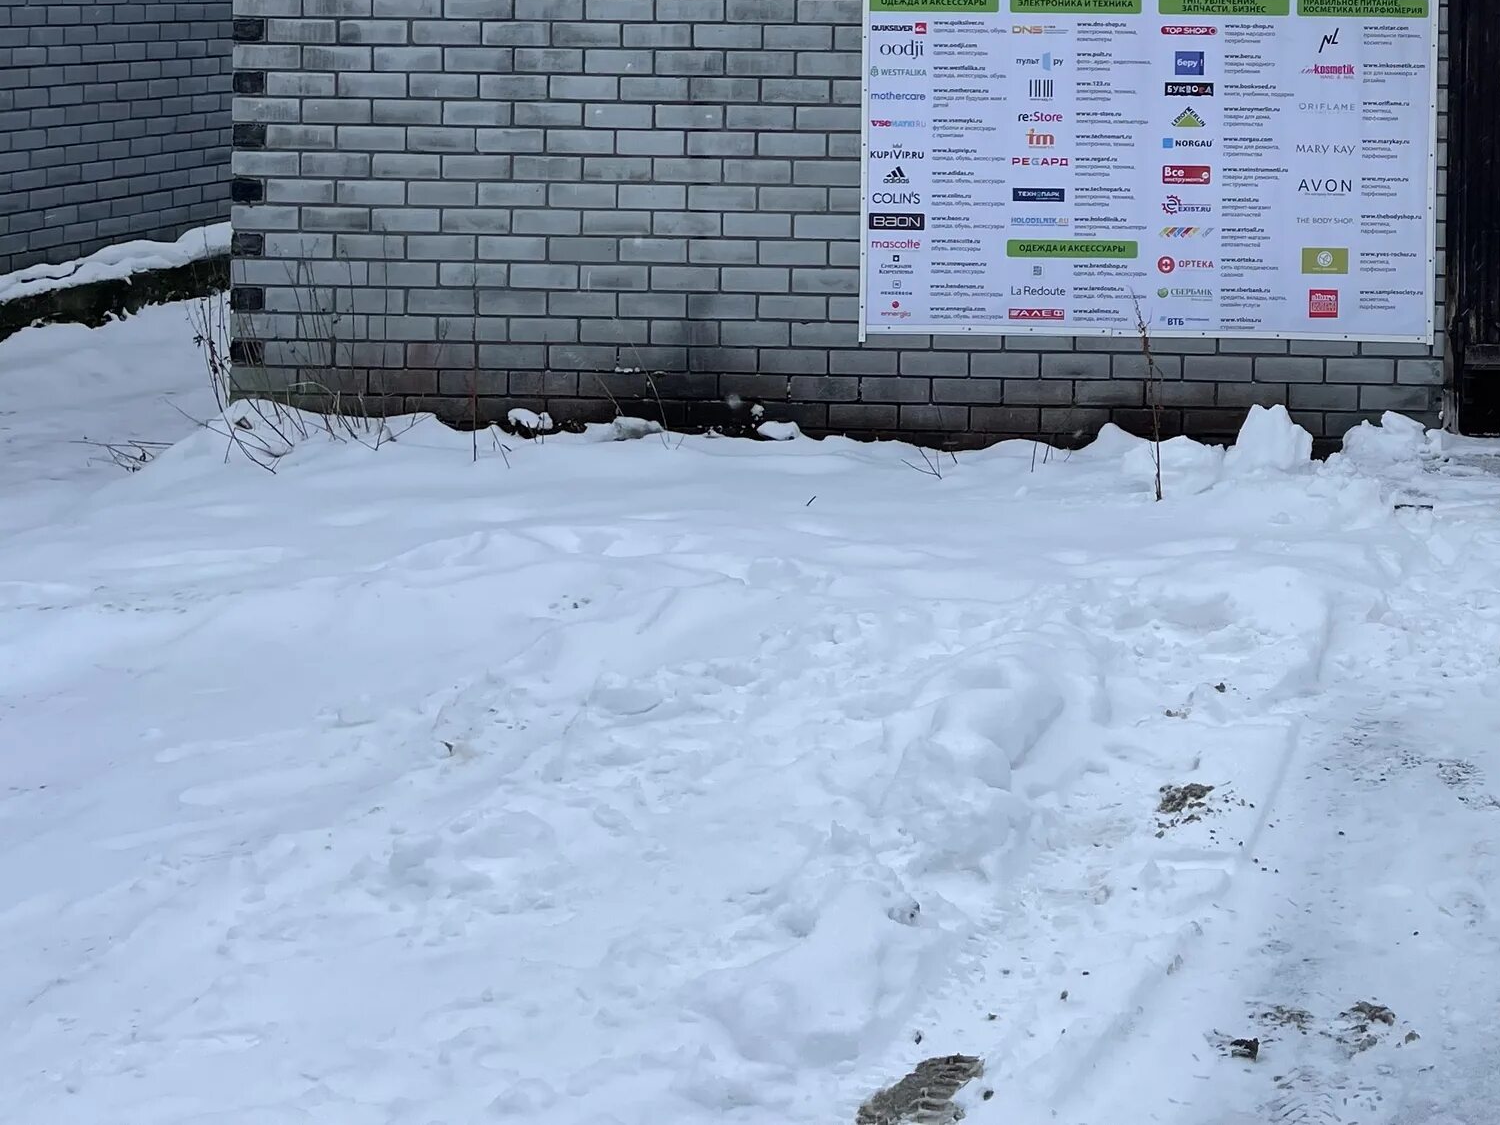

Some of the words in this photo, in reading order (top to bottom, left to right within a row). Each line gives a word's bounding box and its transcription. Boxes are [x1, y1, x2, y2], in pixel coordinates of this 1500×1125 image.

[1018, 0, 1082, 7] ЭЛЕКТРОНИКА
[1359, 0, 1400, 7] ПИТАНИЕ,
[1182, 5, 1230, 13] ЗАПЧАСТИ,
[1232, 5, 1266, 13] БИЗНЕС
[1355, 6, 1361, 14] И
[1363, 6, 1423, 14] ПАРФЮМЕРИЯ
[1012, 26, 1043, 34] DNS
[1318, 28, 1339, 53] NL
[880, 40, 924, 59] oodji
[1177, 59, 1198, 67] беру
[871, 92, 925, 100] mothercare
[1018, 112, 1063, 122] re:Store
[1171, 110, 1188, 127] LEROY
[1186, 106, 1206, 127] MERLIN
[1296, 145, 1329, 154] MARY
[1334, 145, 1355, 155] KAY
[1164, 167, 1184, 176] Все
[1298, 179, 1352, 192] AVON
[872, 192, 920, 204] COLIN'S
[871, 239, 921, 249] mascotte
[1179, 260, 1214, 268] ОРТЕКА
[1011, 286, 1021, 295] La
[1023, 286, 1066, 296] Redoute
